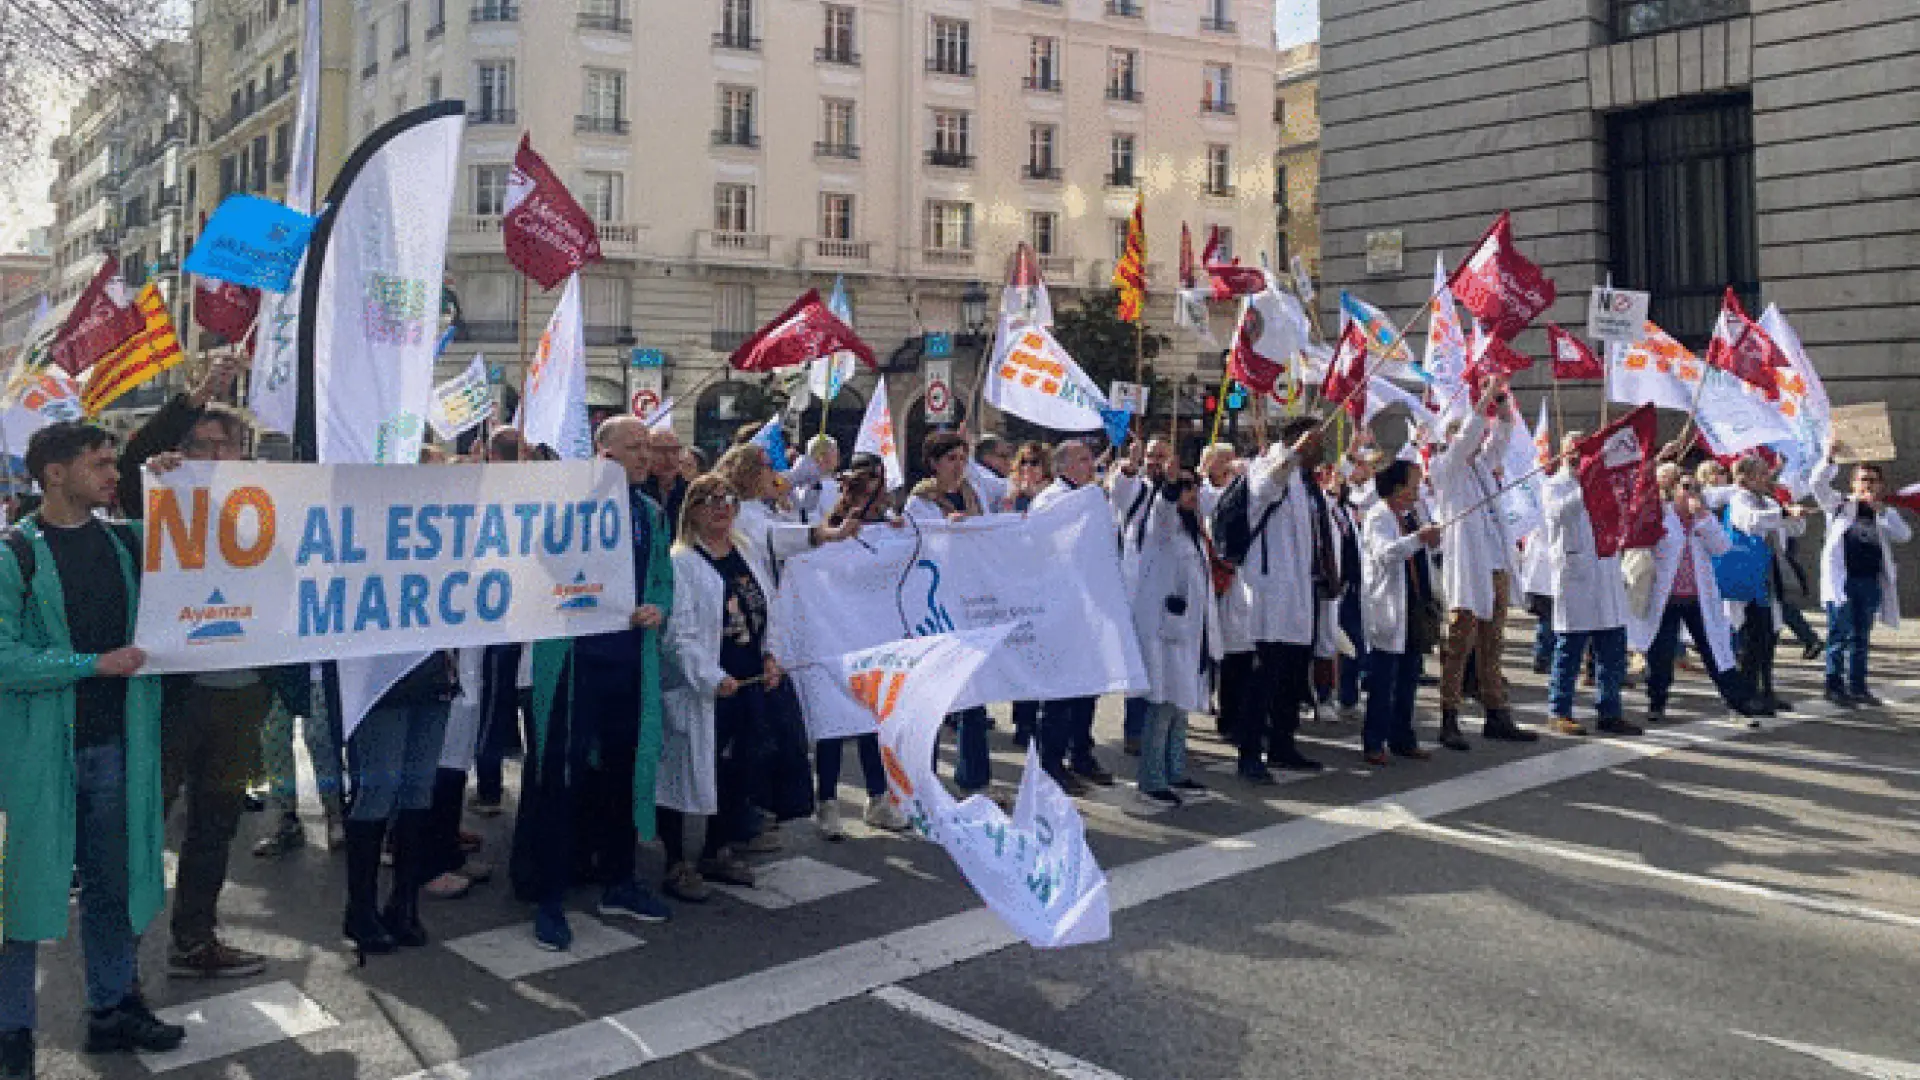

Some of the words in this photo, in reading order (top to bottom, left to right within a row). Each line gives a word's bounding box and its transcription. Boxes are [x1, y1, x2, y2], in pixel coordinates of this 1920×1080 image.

[145, 487, 276, 572] NO
[297, 507, 366, 565] AL
[386, 499, 619, 561] ESTATUTO
[298, 570, 511, 636] MARCO
